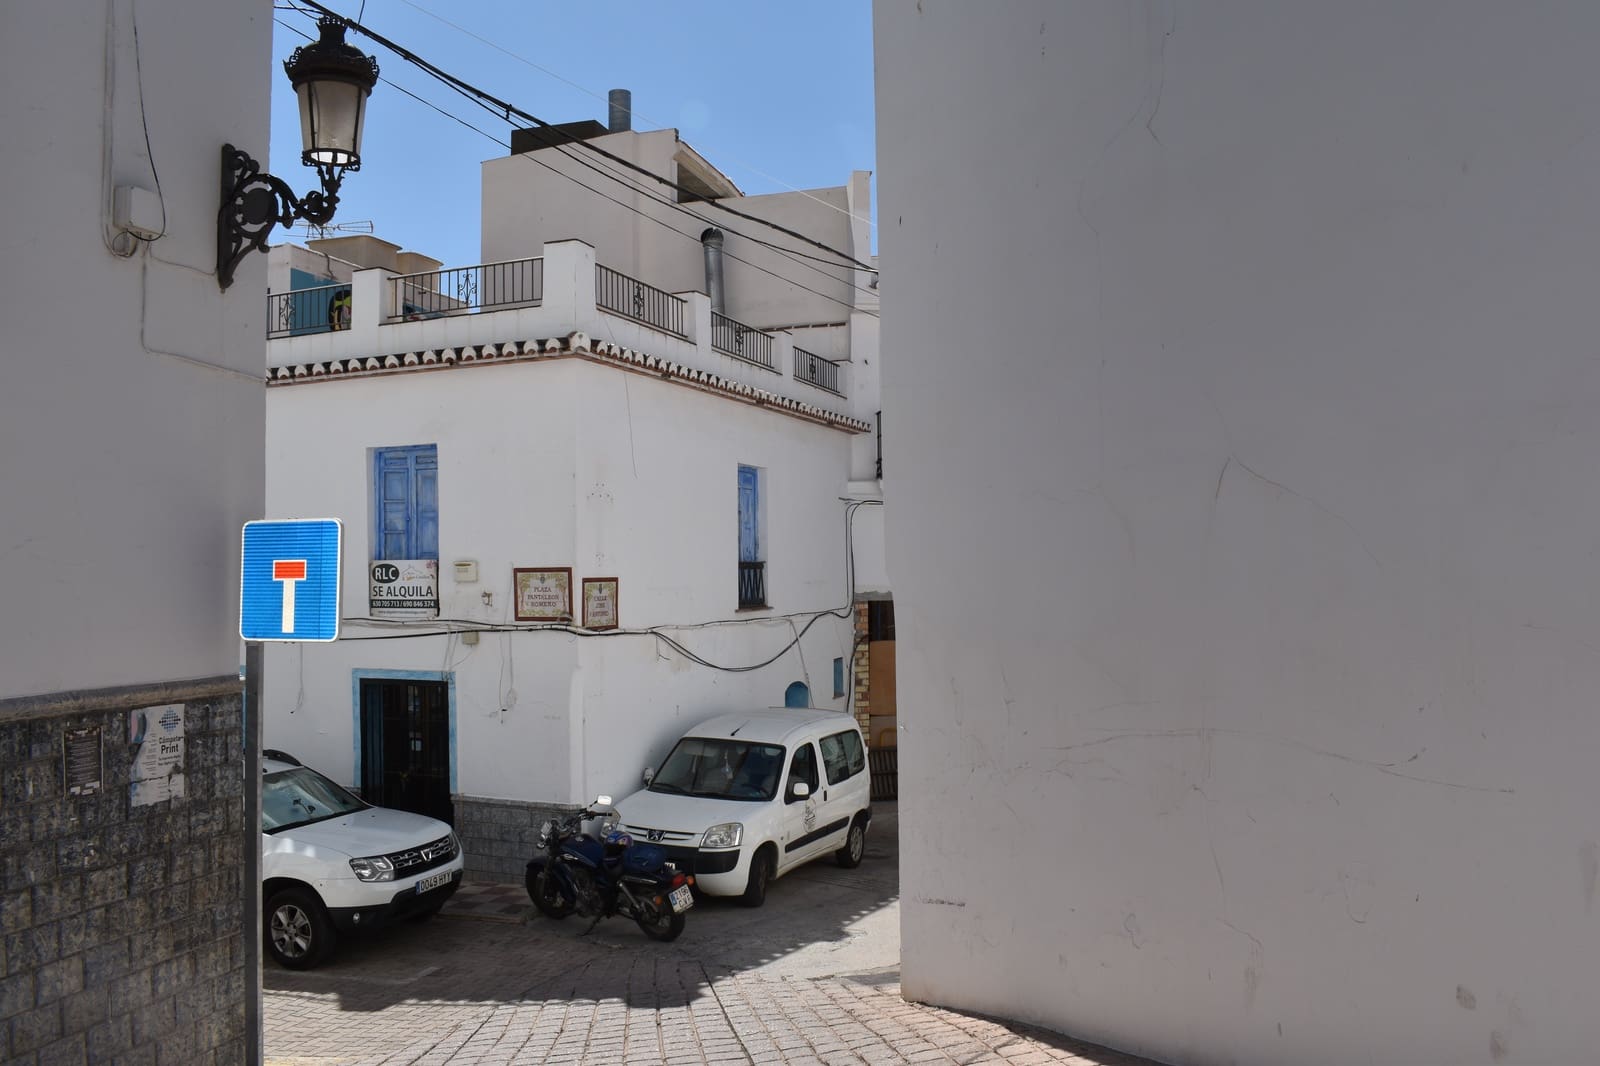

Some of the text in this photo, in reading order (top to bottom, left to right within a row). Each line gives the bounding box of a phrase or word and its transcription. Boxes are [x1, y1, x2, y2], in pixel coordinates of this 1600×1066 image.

[375, 567, 396, 580] RLC
[372, 585, 434, 598] SE ALQUILA
[161, 744, 179, 754] Print
